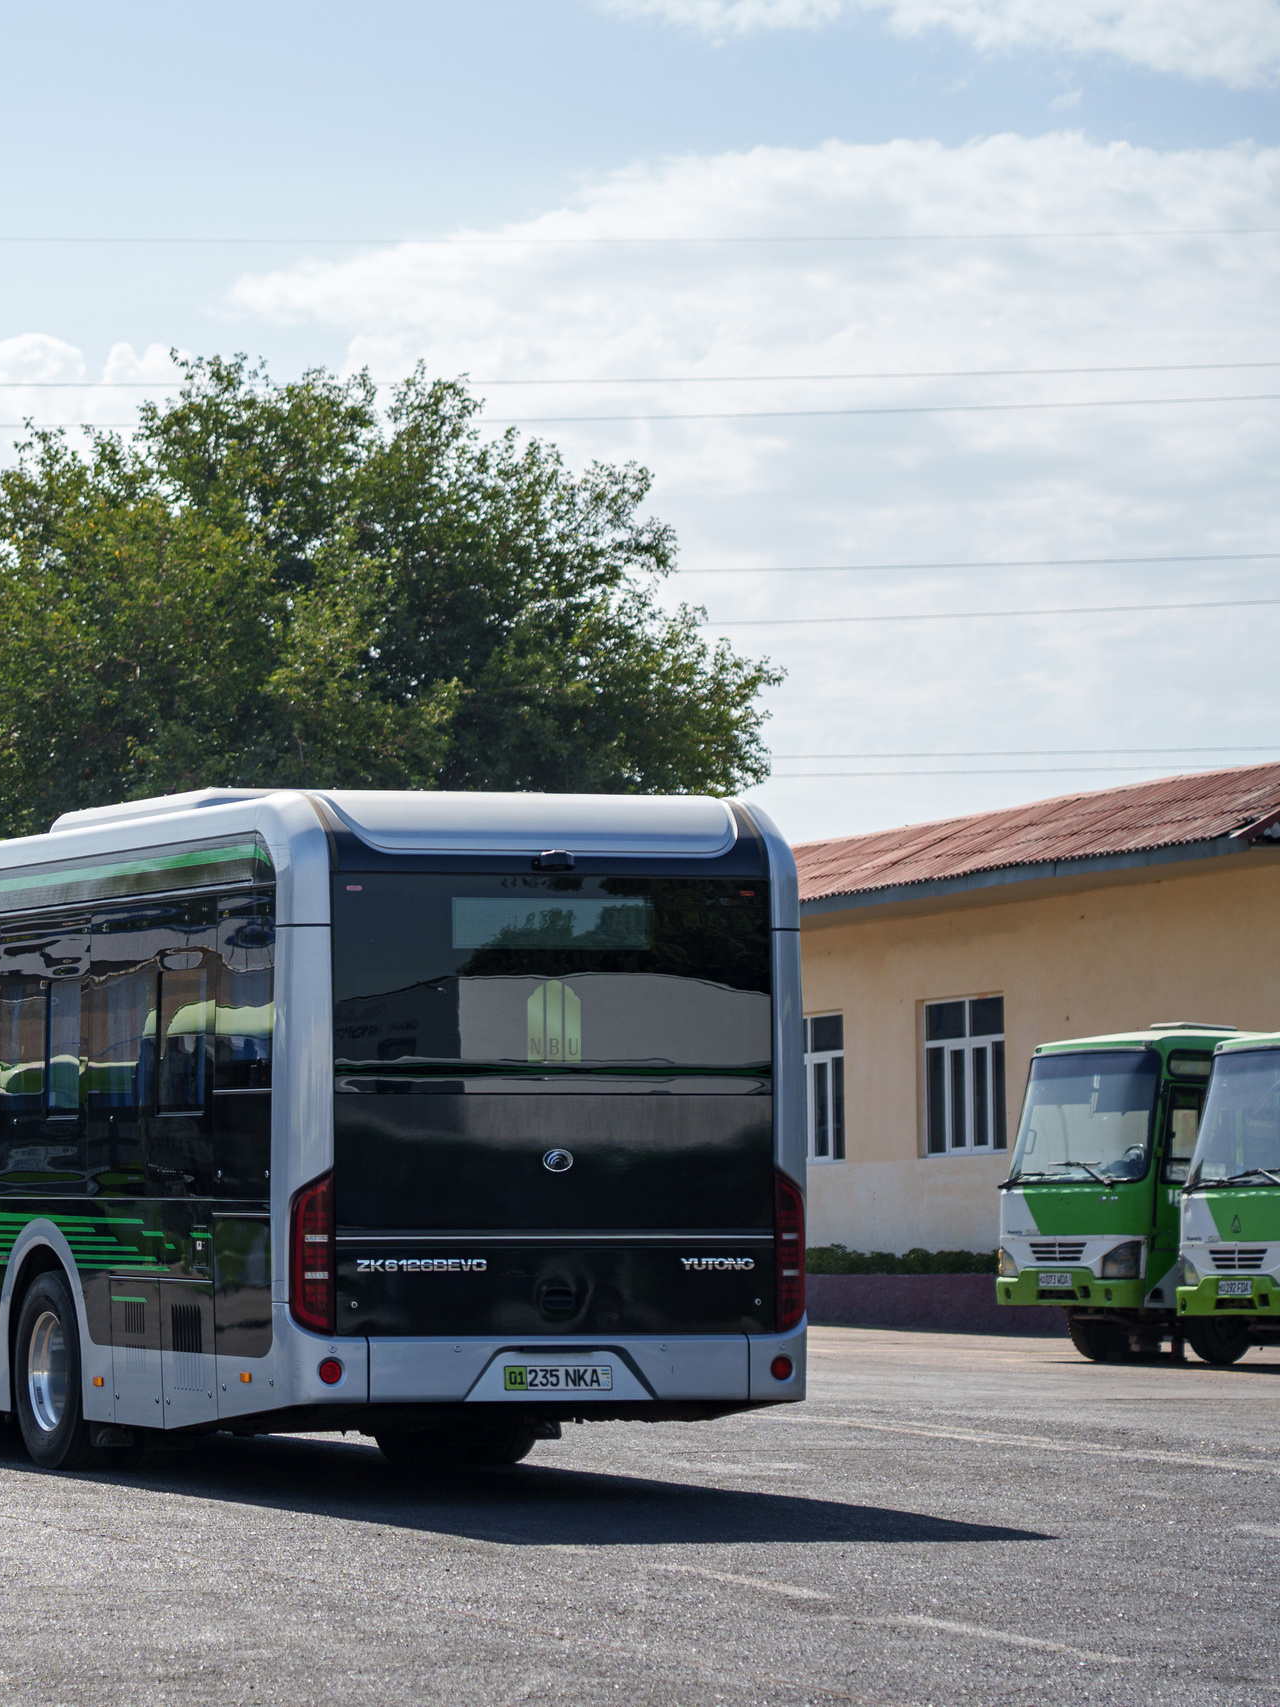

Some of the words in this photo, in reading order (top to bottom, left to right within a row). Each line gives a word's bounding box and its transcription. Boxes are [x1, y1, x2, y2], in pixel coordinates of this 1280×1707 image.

[530, 1037, 579, 1056] NBU
[680, 1257, 756, 1271] YUTONG
[508, 1371, 525, 1386] 01
[528, 1368, 560, 1388] 235
[564, 1368, 601, 1388] NKA
